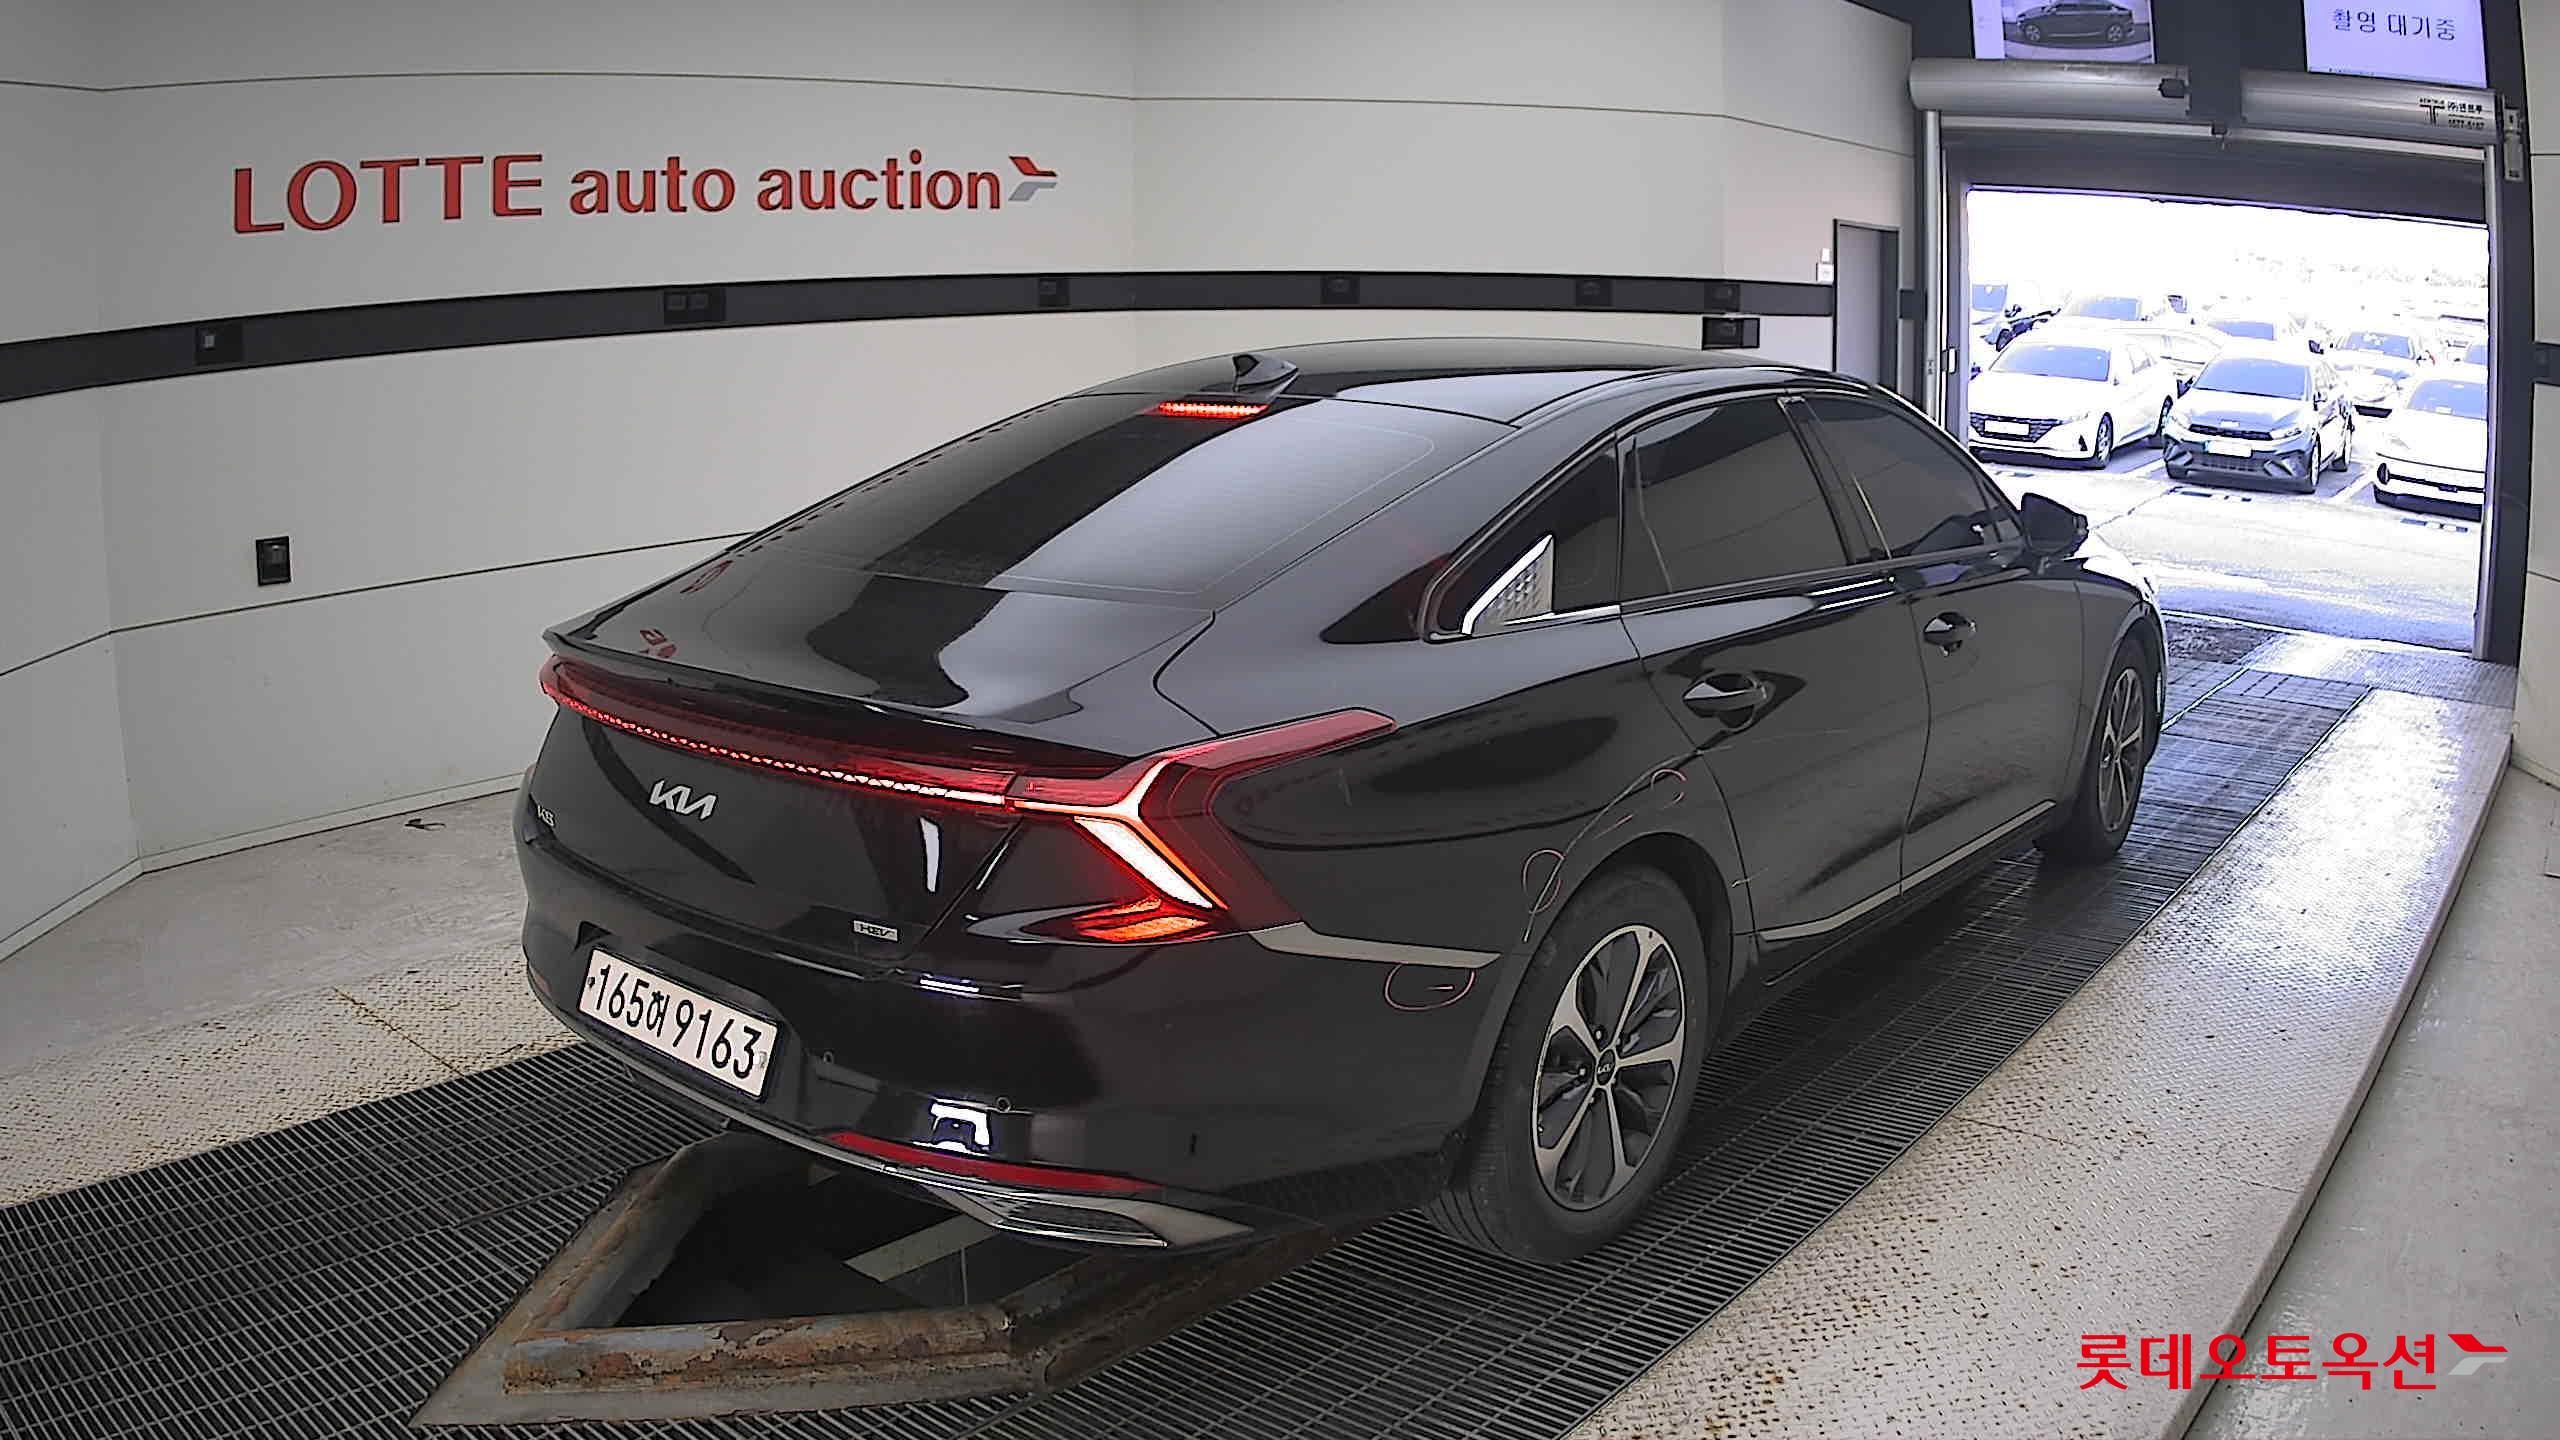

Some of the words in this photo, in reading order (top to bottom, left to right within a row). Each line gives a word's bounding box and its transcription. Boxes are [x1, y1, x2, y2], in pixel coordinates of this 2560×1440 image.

[2333, 8, 2376, 33] 촬영
[2387, 14, 2456, 41] 대기중
[234, 154, 543, 234] LOTTE
[569, 156, 736, 215] auto
[757, 149, 1001, 213] auction
[649, 778, 717, 820] KIA
[857, 921, 897, 939] HEV
